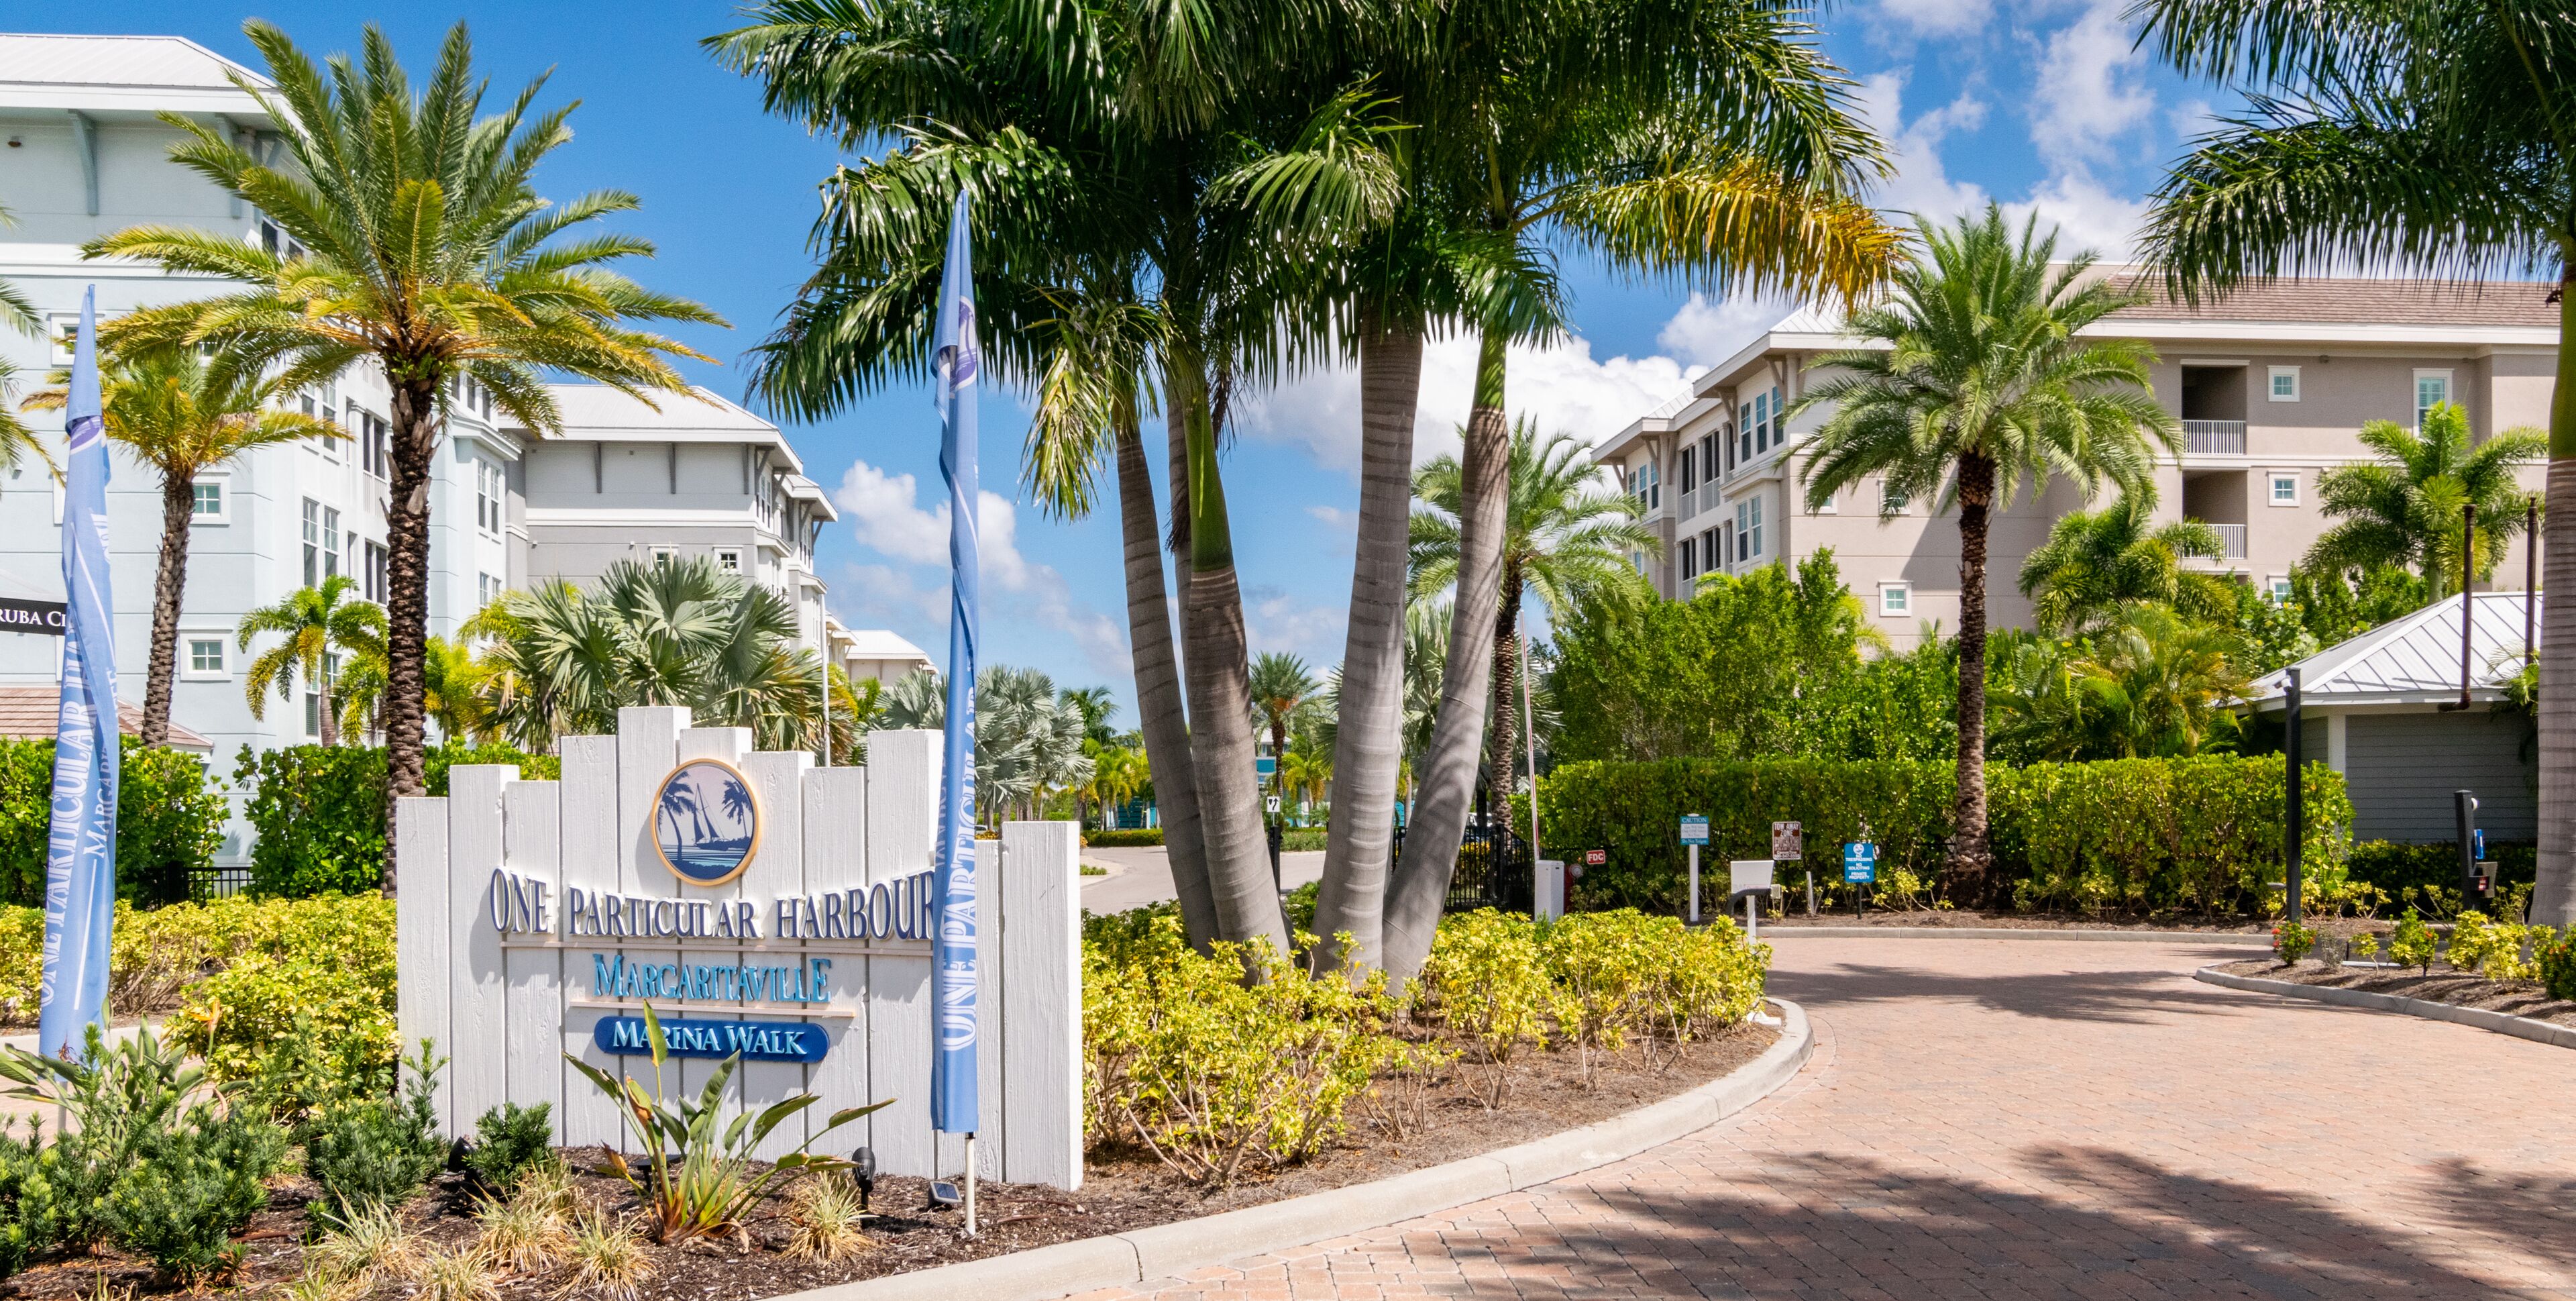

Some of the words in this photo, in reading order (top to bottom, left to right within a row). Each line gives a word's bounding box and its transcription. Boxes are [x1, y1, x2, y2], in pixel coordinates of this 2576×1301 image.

[47, 700, 96, 927] PARTICULAR
[1588, 853, 1604, 862] FDC
[490, 868, 553, 933] ONE
[569, 886, 762, 939] PARTICULAR
[775, 869, 934, 939] HARBOUR
[593, 953, 832, 1002] MARGARITAVILLE
[943, 959, 977, 1051] ONE
[724, 1025, 808, 1055] WALK
